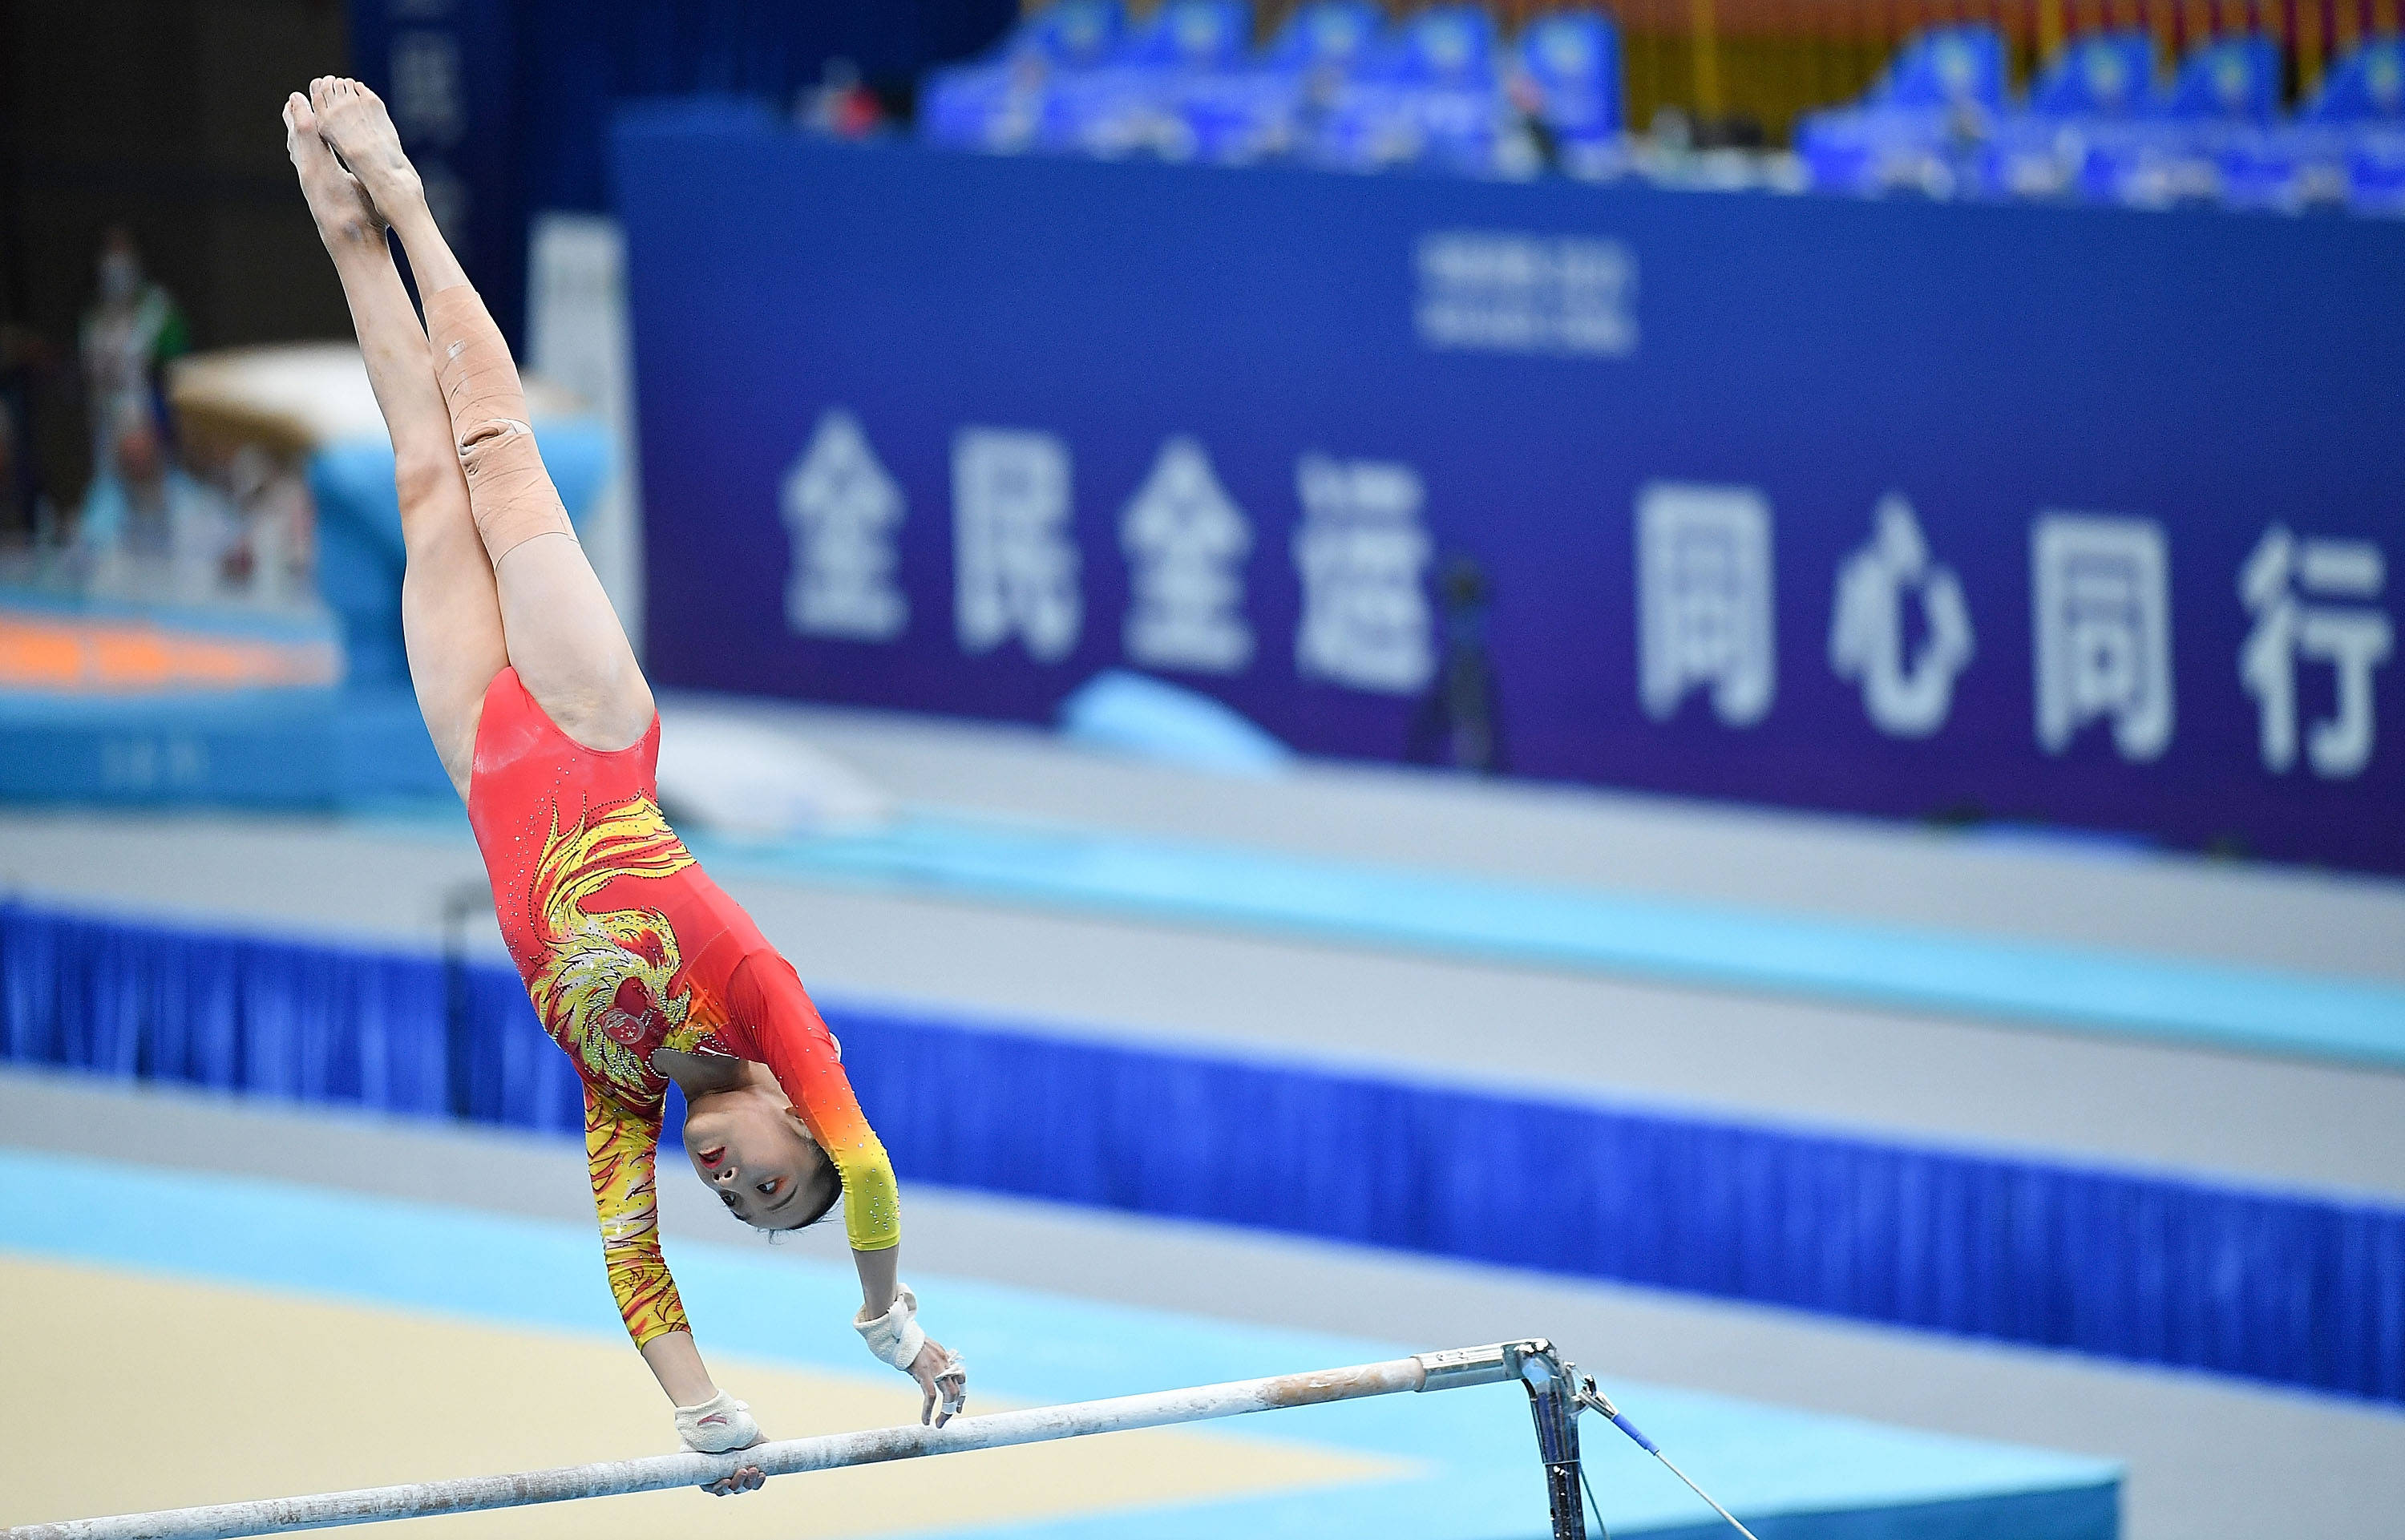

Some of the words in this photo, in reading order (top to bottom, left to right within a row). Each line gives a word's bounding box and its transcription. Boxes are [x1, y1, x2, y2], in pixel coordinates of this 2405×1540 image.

[781, 409, 1435, 695] 全民全运
[1637, 483, 2391, 776] 同心同行
